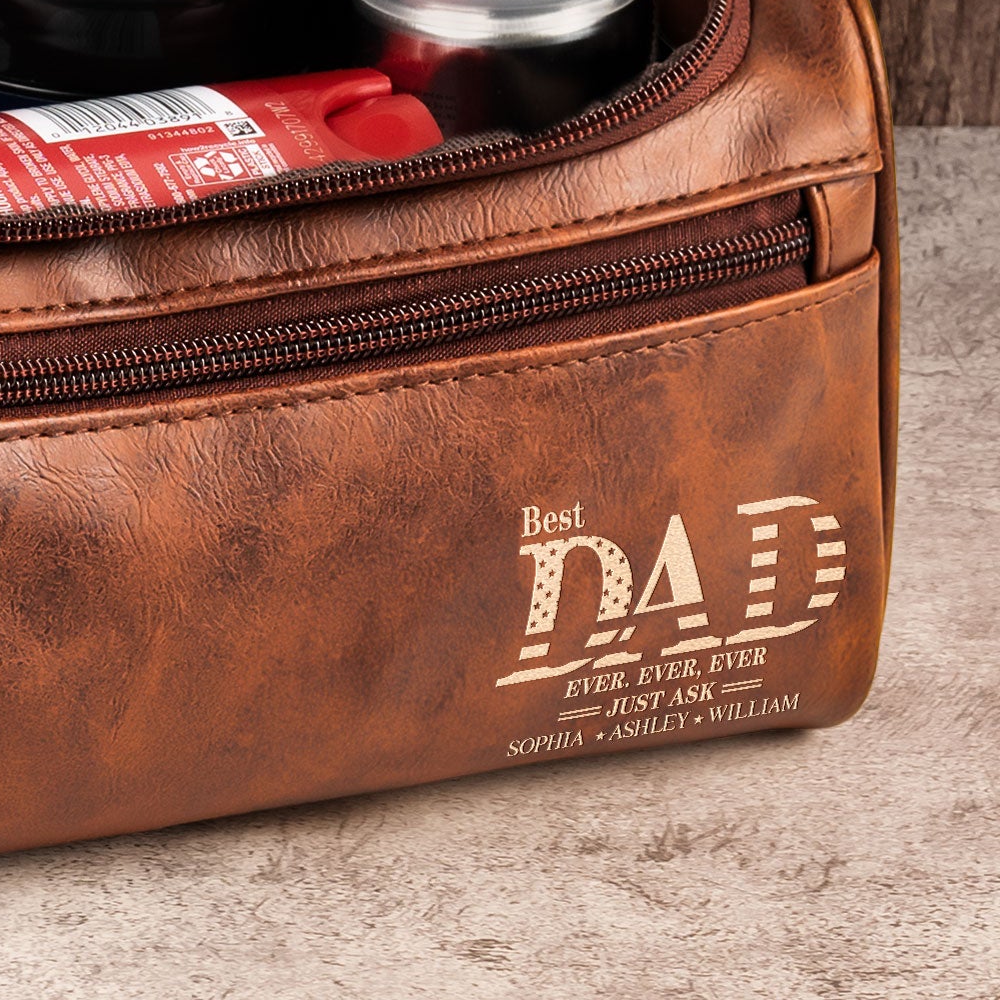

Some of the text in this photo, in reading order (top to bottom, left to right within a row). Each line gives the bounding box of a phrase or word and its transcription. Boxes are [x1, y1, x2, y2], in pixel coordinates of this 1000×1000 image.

[81, 120, 140, 134] 12044
[144, 111, 202, 126] 03891
[148, 125, 215, 140] 91344802
[21, 141, 38, 152] AS
[29, 149, 48, 163] ONLY
[17, 155, 43, 177] BROKEN
[39, 162, 57, 176] USE
[238, 148, 263, 176] PLASTIC
[253, 150, 270, 169] STICK
[33, 177, 49, 187] TO
[125, 169, 157, 210] ETRASODIUM
[101, 182, 125, 207] SODIUM
[521, 501, 586, 538] Best
[496, 496, 847, 687] DAD
[637, 659, 702, 686] EVER,
[708, 647, 767, 673] EVER
[606, 681, 716, 717] JUST ASK
[507, 693, 801, 757] SOPHIA ASHLEY WILLIAM
